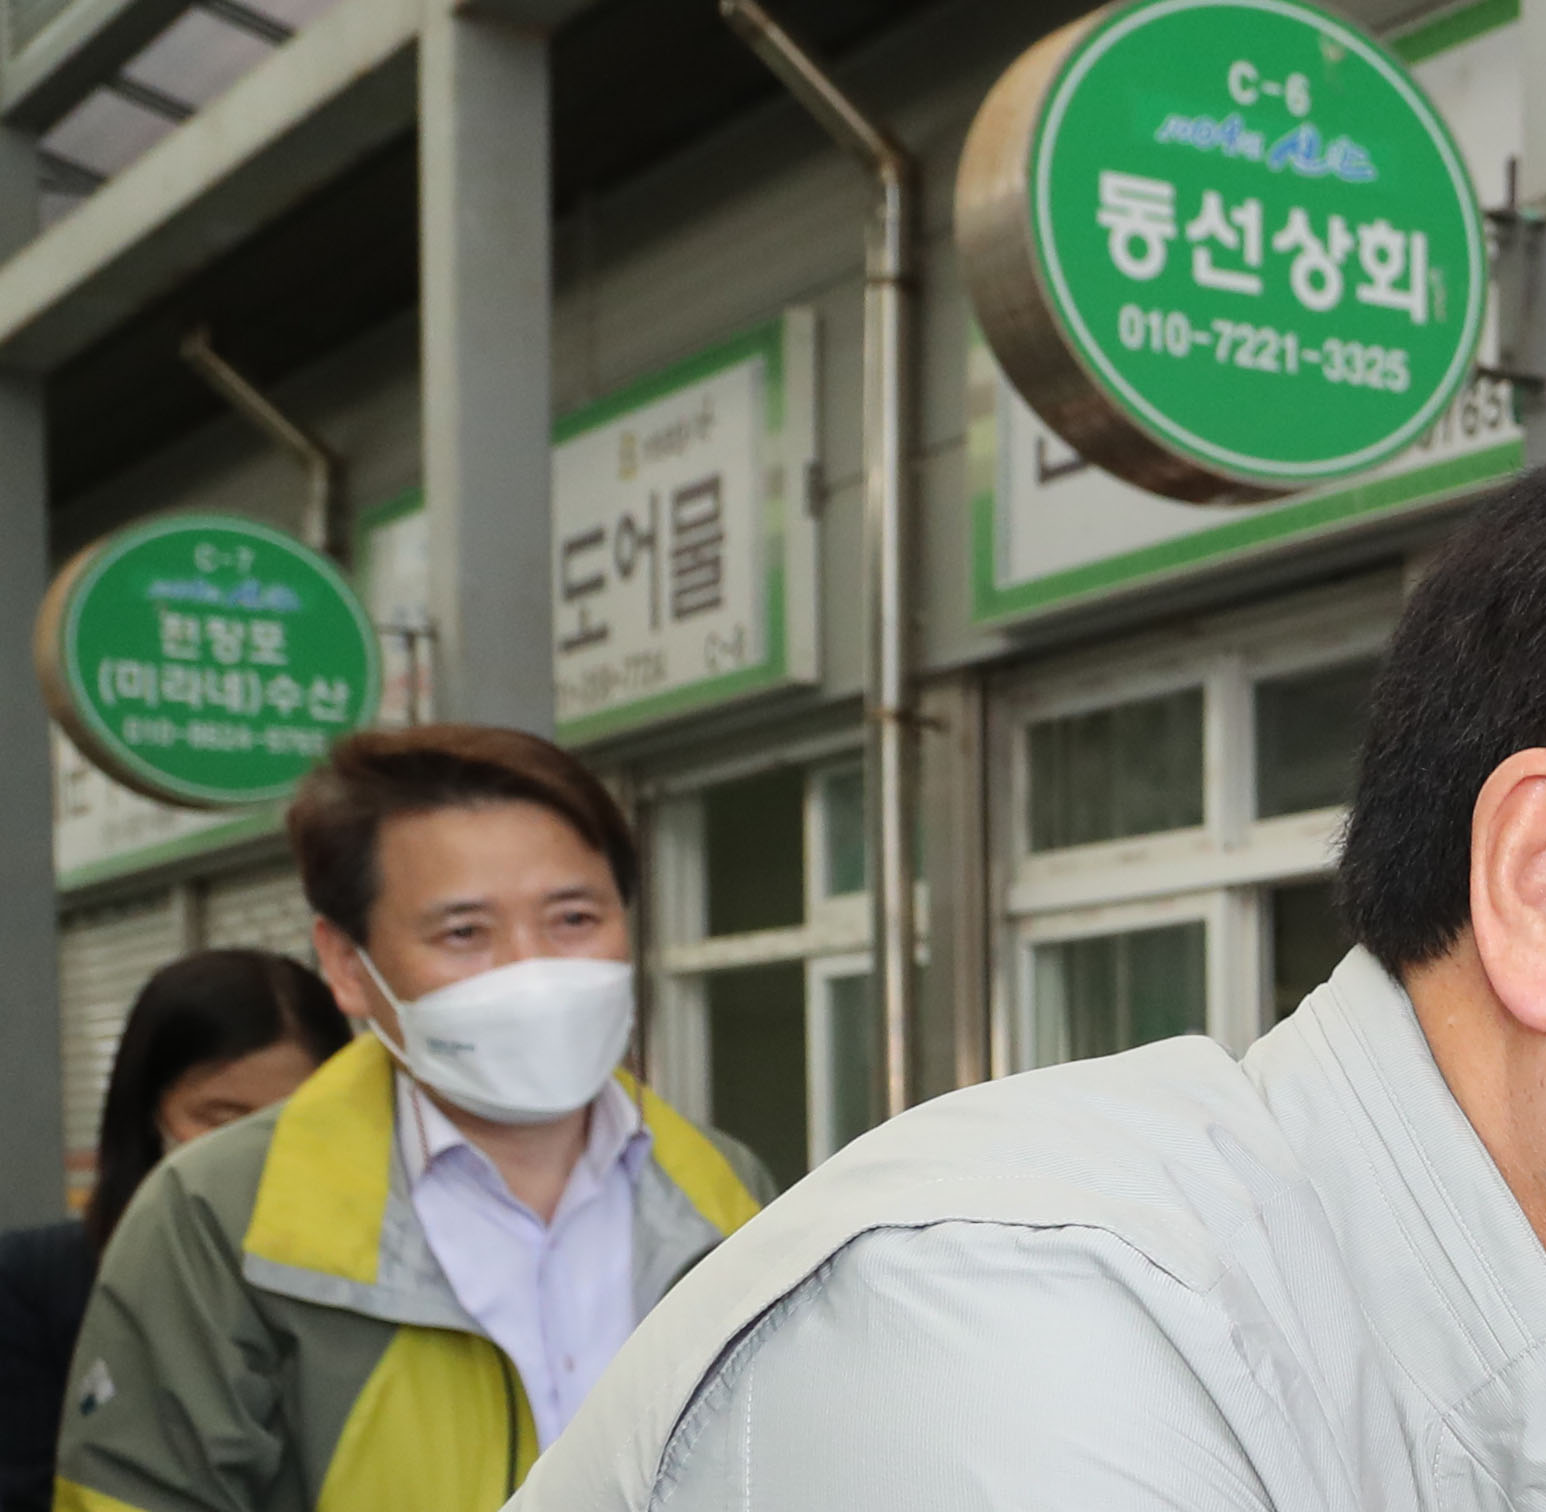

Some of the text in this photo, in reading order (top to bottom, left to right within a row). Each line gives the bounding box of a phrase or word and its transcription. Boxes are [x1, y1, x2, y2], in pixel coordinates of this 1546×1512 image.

[1228, 60, 1311, 117] C-6
[1097, 170, 1429, 325] 동선상회
[1118, 303, 1412, 395] 010-7221-3325
